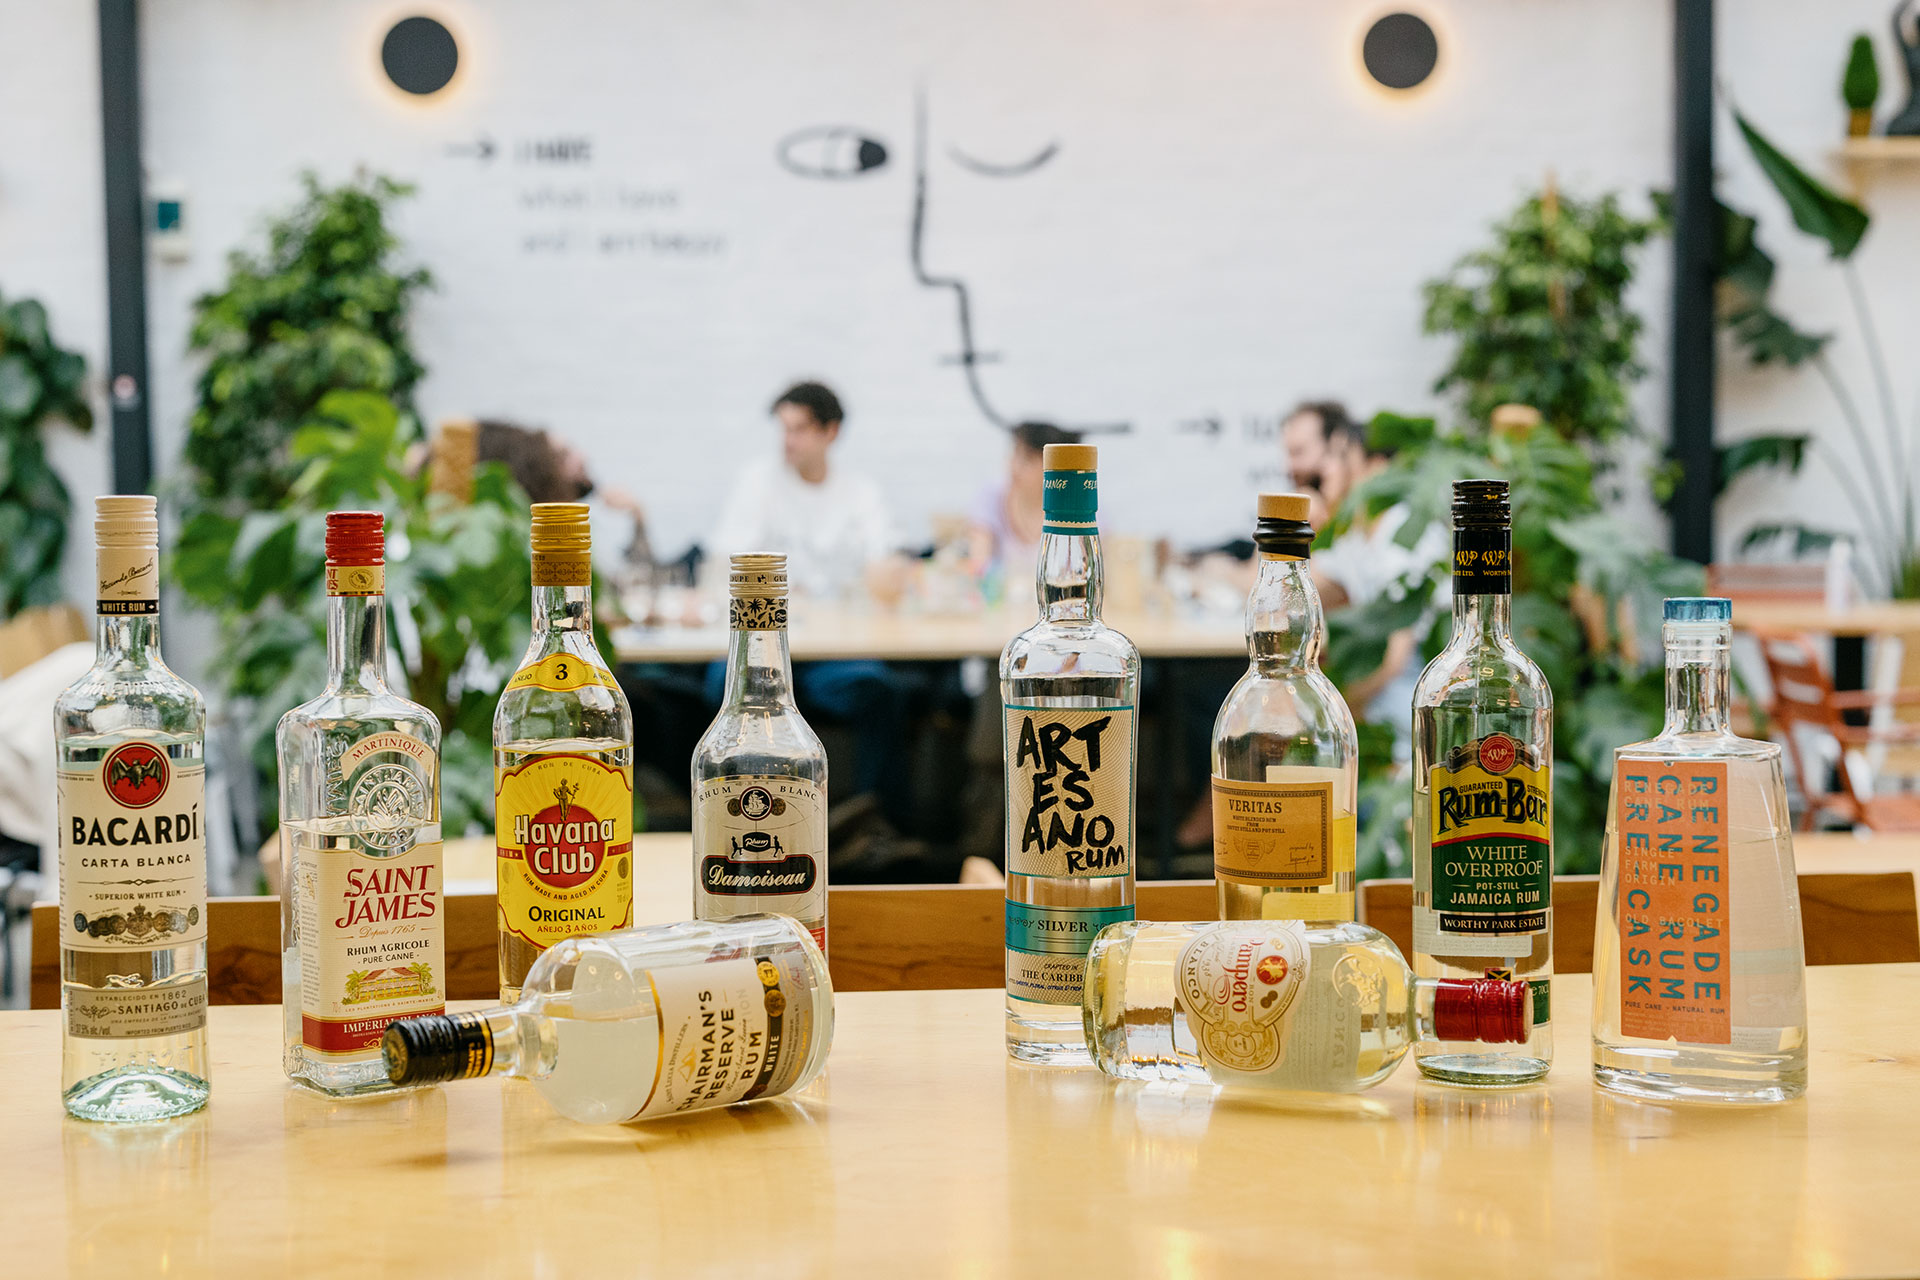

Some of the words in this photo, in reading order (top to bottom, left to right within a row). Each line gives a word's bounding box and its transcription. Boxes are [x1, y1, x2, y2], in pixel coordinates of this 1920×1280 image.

[102, 602, 126, 612] WHITE
[128, 602, 146, 612] RUM
[555, 663, 568, 680] 3
[352, 738, 425, 761] MARTINIQUE
[1017, 716, 1112, 772] ART
[581, 764, 601, 776] CUBA
[699, 786, 732, 802] RHUM
[780, 786, 817, 800] BLANC
[1032, 770, 1094, 814] ES
[1459, 781, 1503, 793] GUARANTEED
[1228, 799, 1282, 814] VERITAS
[1437, 776, 1547, 835] Rum-Bar
[72, 802, 198, 846] BACARDÍ
[514, 814, 614, 845] Havana
[1022, 806, 1115, 854] ANO
[1657, 775, 1683, 882] CANE
[82, 858, 129, 868] CARTA
[137, 854, 191, 867] BLANCA
[533, 845, 595, 875] Club
[1065, 845, 1125, 874] RUM
[1466, 845, 1528, 861] WHITE
[1625, 846, 1675, 859] SINGLE
[1445, 860, 1543, 877] OVERPROOF
[1625, 860, 1658, 872] FARM
[344, 865, 435, 897] SAINT
[708, 864, 807, 887] Damoiseau
[1625, 873, 1676, 887] ORIGIN
[523, 873, 534, 888] RUM
[535, 884, 551, 898] MADE
[570, 890, 588, 900] AGED
[588, 884, 596, 893] IN
[596, 869, 608, 886] CUBA
[1476, 882, 1520, 891] POT-STILL
[1691, 776, 1721, 1000] RENEGADE
[1450, 892, 1512, 905] JAMAICA
[1516, 890, 1540, 903] RUM
[335, 892, 436, 929] JAMES
[528, 905, 605, 922] ORIGINAL
[391, 924, 416, 935] 1765
[536, 923, 563, 933] AÑEJO
[564, 924, 571, 934] 3
[574, 923, 598, 932] AÑOS
[1037, 920, 1089, 933] SILVER
[1444, 918, 1488, 929] WORTHY
[1491, 920, 1517, 929] PARK
[1518, 917, 1544, 928] ESTATE
[1659, 916, 1724, 929] BACOLET
[347, 945, 377, 956] RHUM
[380, 939, 430, 952] AGRICOLE
[363, 956, 383, 965] PURE
[386, 952, 414, 962] CANNE
[1658, 921, 1685, 999] RUM
[1021, 969, 1039, 979] THE
[1041, 973, 1083, 982] CARIBB
[1187, 941, 1209, 999] BLANCO
[162, 990, 187, 1000] 1862
[118, 1001, 178, 1015] SANTIAGO
[1624, 1001, 1642, 1010] PURE
[1645, 1002, 1662, 1011] CANE
[1672, 1005, 1705, 1014] NATURAL
[704, 1008, 734, 1100] RESERVE
[741, 1031, 762, 1080] RUM
[764, 1035, 780, 1072] WHITE
